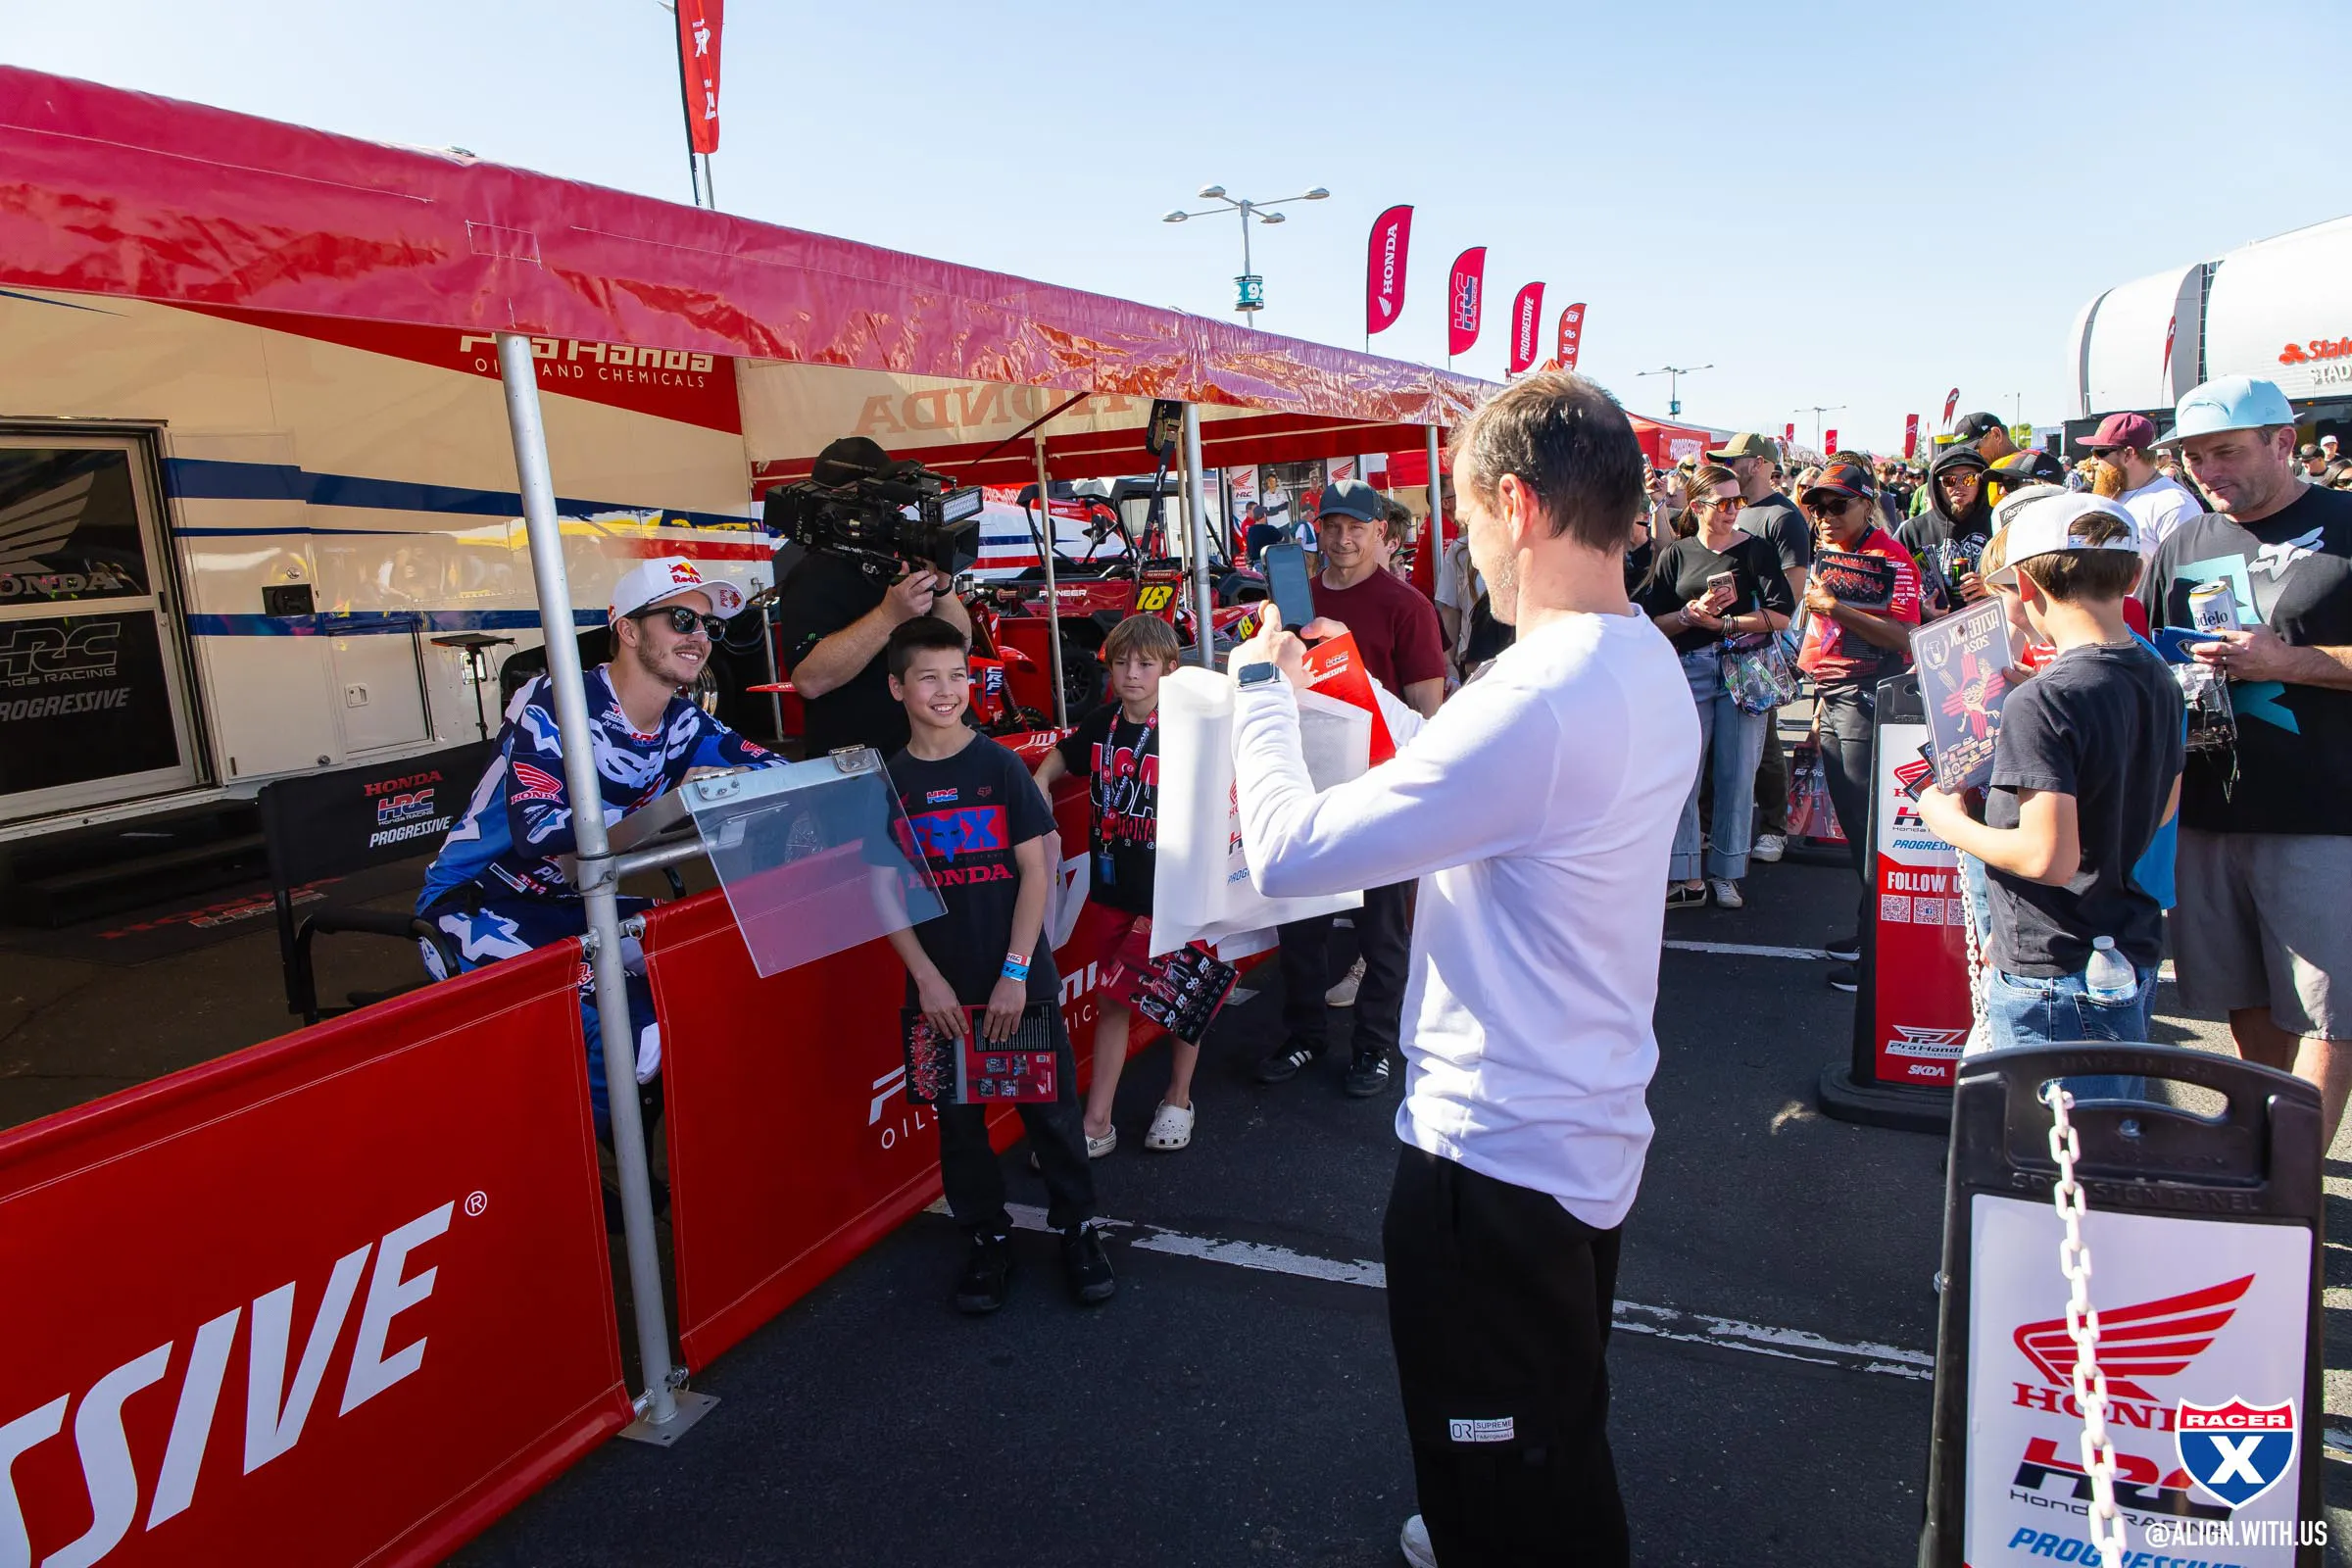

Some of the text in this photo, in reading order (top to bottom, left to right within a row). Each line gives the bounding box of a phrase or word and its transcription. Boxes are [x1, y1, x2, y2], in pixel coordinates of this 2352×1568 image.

[1384, 222, 1398, 295] HONDA
[1520, 296, 1535, 362] PROGRESSIVE
[2309, 336, 2352, 361] Stat
[542, 364, 584, 378] AND
[598, 368, 705, 388] CHEMICALS
[2309, 364, 2352, 384] STAD
[0, 571, 123, 598] ONDA
[1136, 585, 1174, 611] 18
[1238, 613, 1254, 640] 18
[2193, 611, 2230, 627] odelo
[0, 667, 118, 688] nda RACING
[1313, 663, 1348, 684] OGRESSIVE
[0, 687, 131, 722] ROGRESSIVE
[363, 769, 444, 797] HONDA
[377, 788, 434, 821] HRC
[511, 792, 564, 806] HONDA
[368, 815, 454, 848] PROGRESSIVE
[907, 863, 1013, 889] HONDA
[1887, 870, 1947, 893] FOLLOW
[1198, 956, 1210, 974] 29
[1186, 976, 1200, 991] 96
[1163, 1009, 1176, 1028] 30
[1907, 1064, 1945, 1077] SKDA
[2171, 1189, 2262, 1211] PANEL
[1475, 1419, 1513, 1430] SUPREME
[2010, 1490, 2089, 1517] Hond
